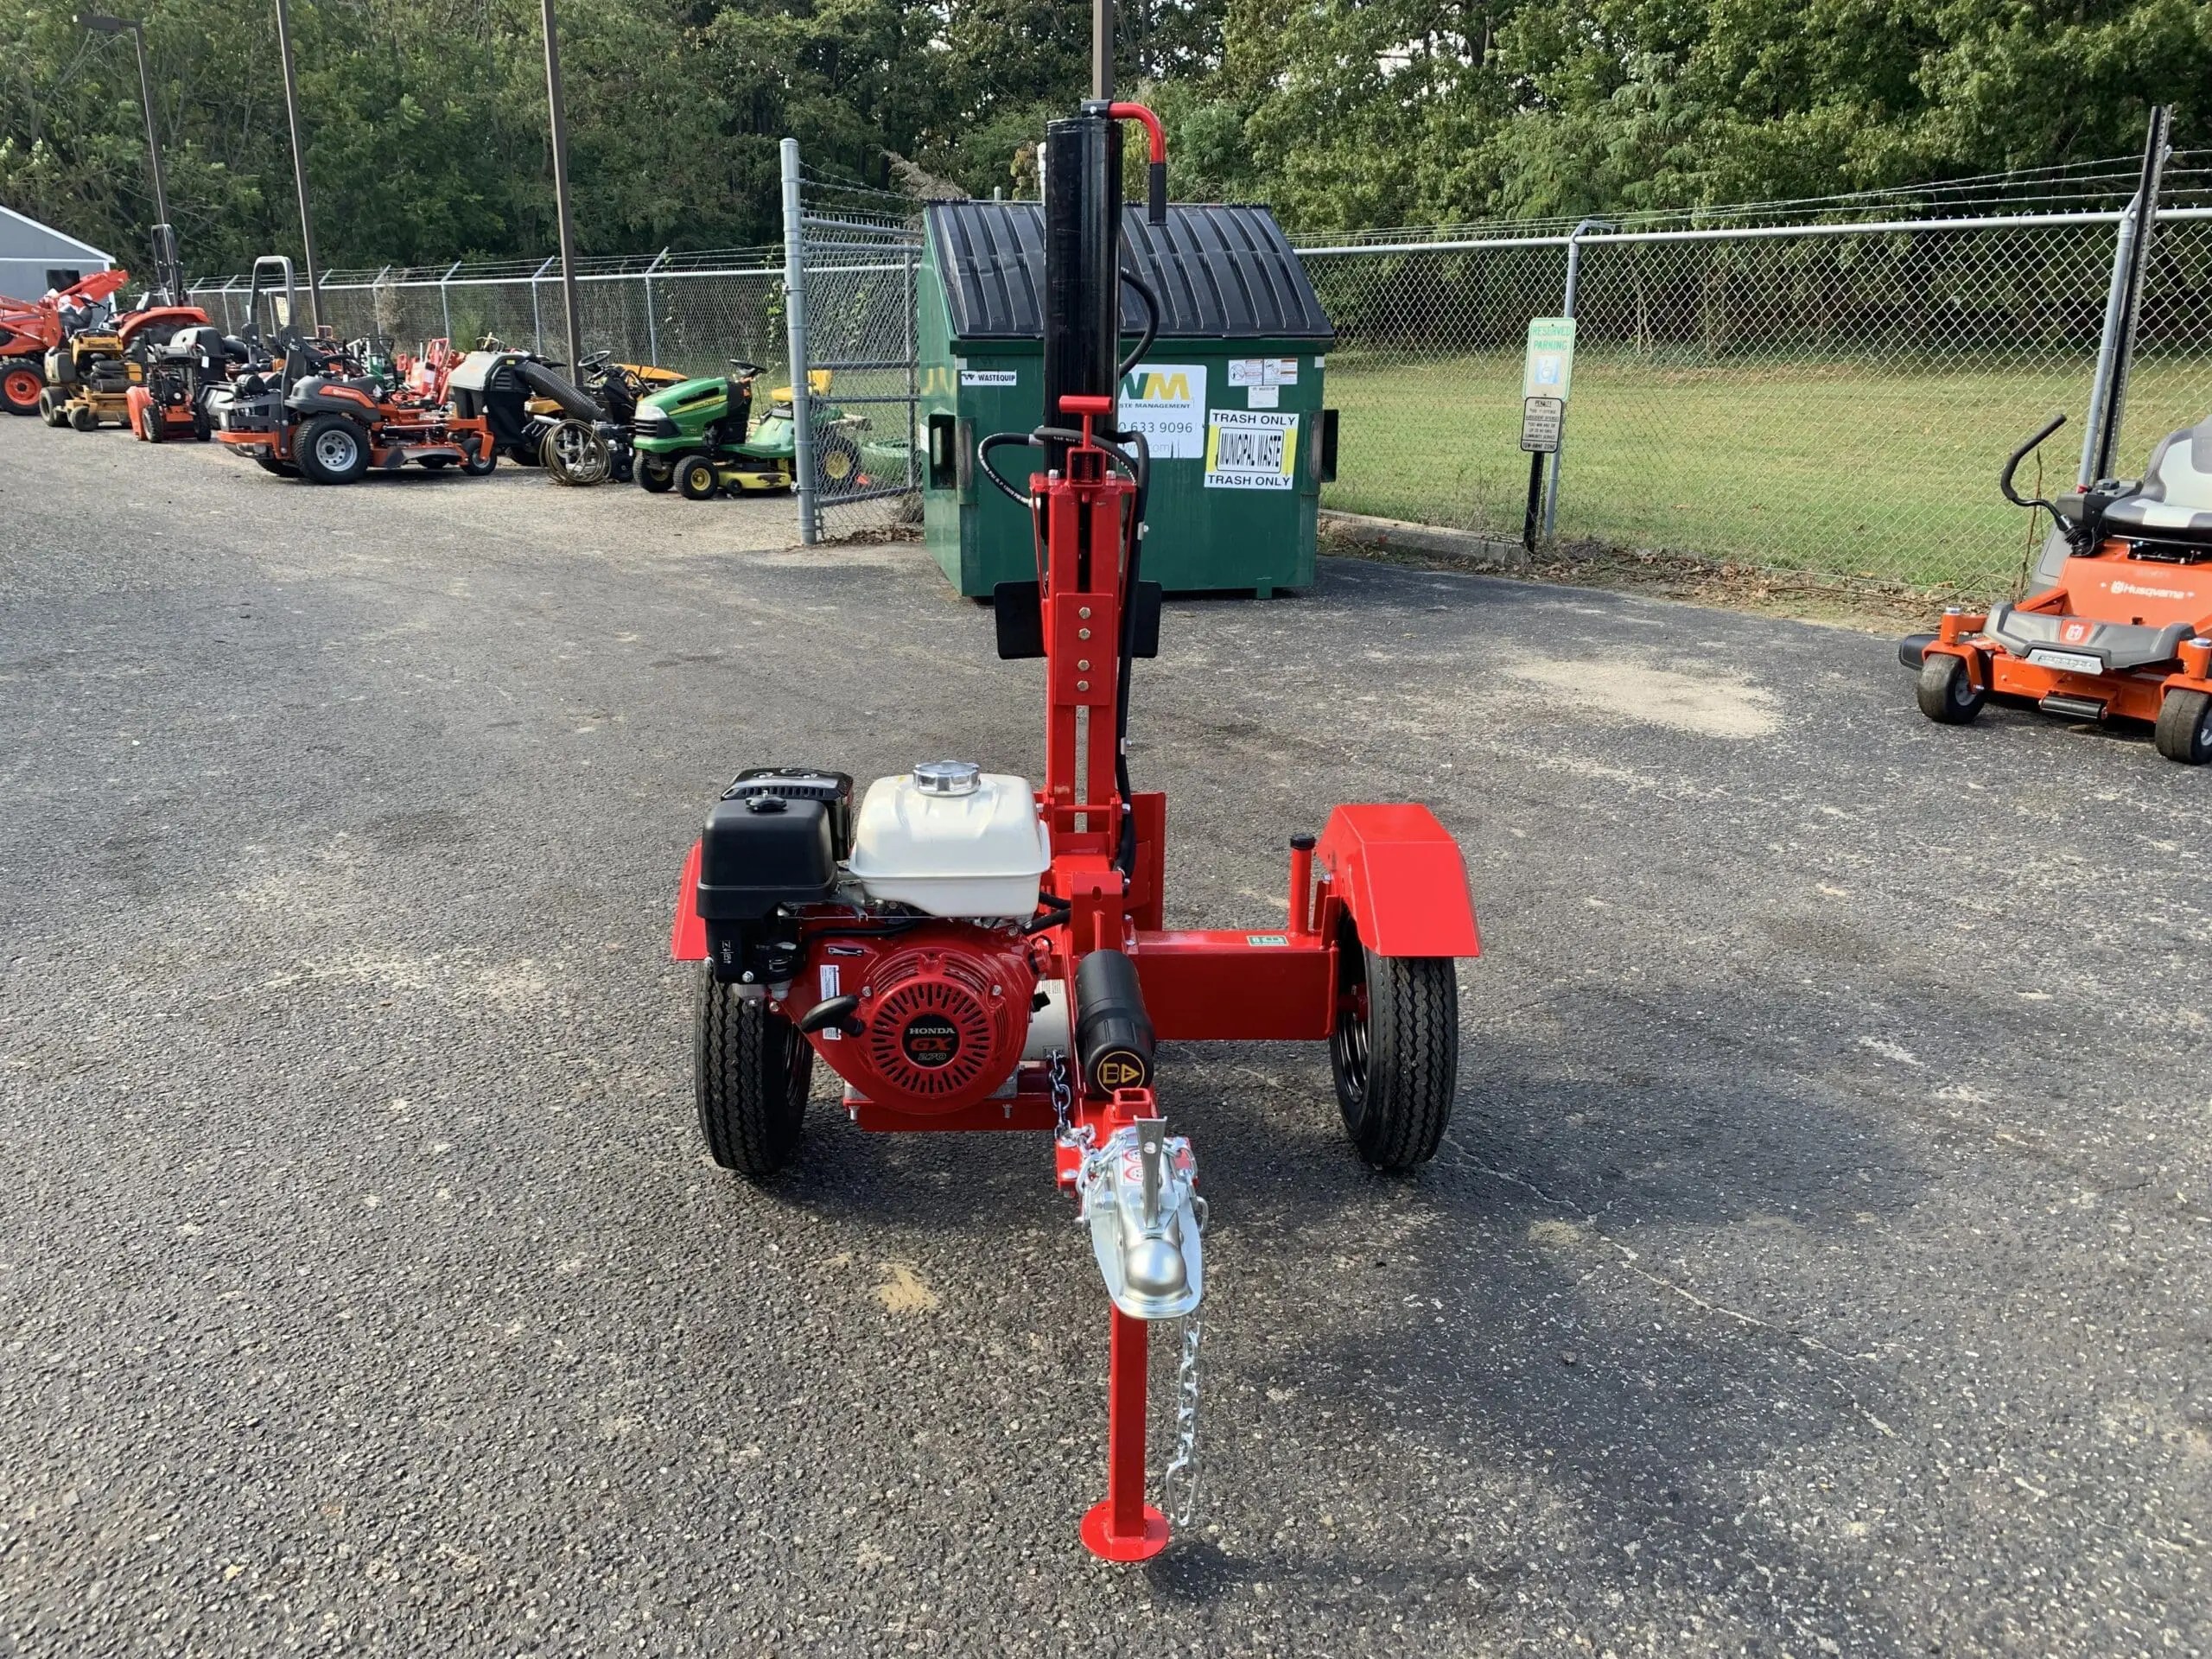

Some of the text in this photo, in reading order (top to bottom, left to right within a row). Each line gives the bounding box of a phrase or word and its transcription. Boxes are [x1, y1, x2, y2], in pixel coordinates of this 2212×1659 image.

[1532, 326, 1572, 336] RESERVED
[1534, 340, 1567, 351] PARKING
[1212, 413, 1295, 425] TRASH ONLY
[1130, 422, 1154, 433] 633
[1160, 422, 1192, 433] 9096
[1220, 433, 1281, 467] MUNICIPAL WASTE
[1208, 474, 1290, 486] TRASH ONLY
[2124, 583, 2184, 599] Husqvarna
[912, 1037, 953, 1051] GX
